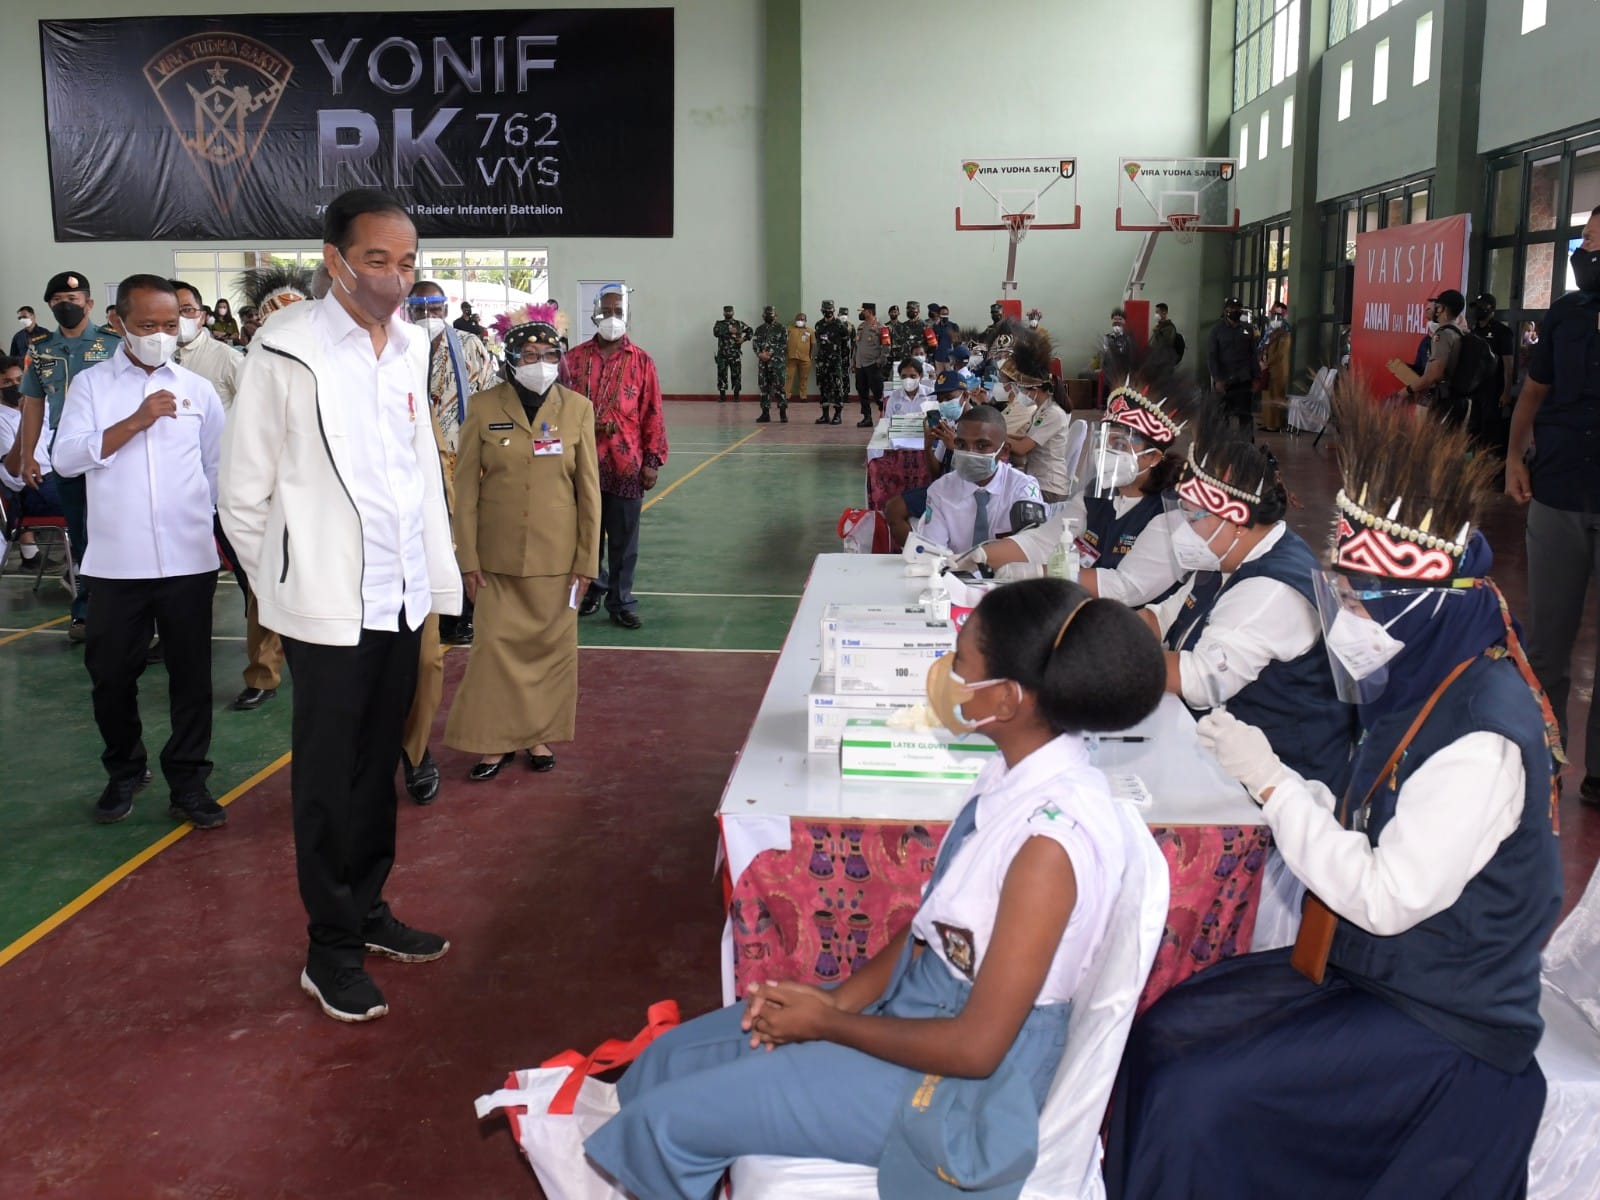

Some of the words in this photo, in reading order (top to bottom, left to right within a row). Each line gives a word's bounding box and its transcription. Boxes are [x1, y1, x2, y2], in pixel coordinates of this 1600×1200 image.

[310, 35, 560, 96] YONIF
[475, 112, 561, 149] 762
[317, 107, 465, 189] RK
[475, 156, 561, 189] VYS
[1001, 166, 1031, 174] YUDHA
[1033, 166, 1060, 174] SAKTI
[417, 204, 454, 215] Raider
[457, 204, 507, 215] Infanteri
[510, 204, 563, 215] Battalion
[1368, 241, 1444, 284] VAKSIN
[1363, 302, 1390, 331] AMAN
[1406, 303, 1430, 334] HAL
[895, 667, 909, 677] 100
